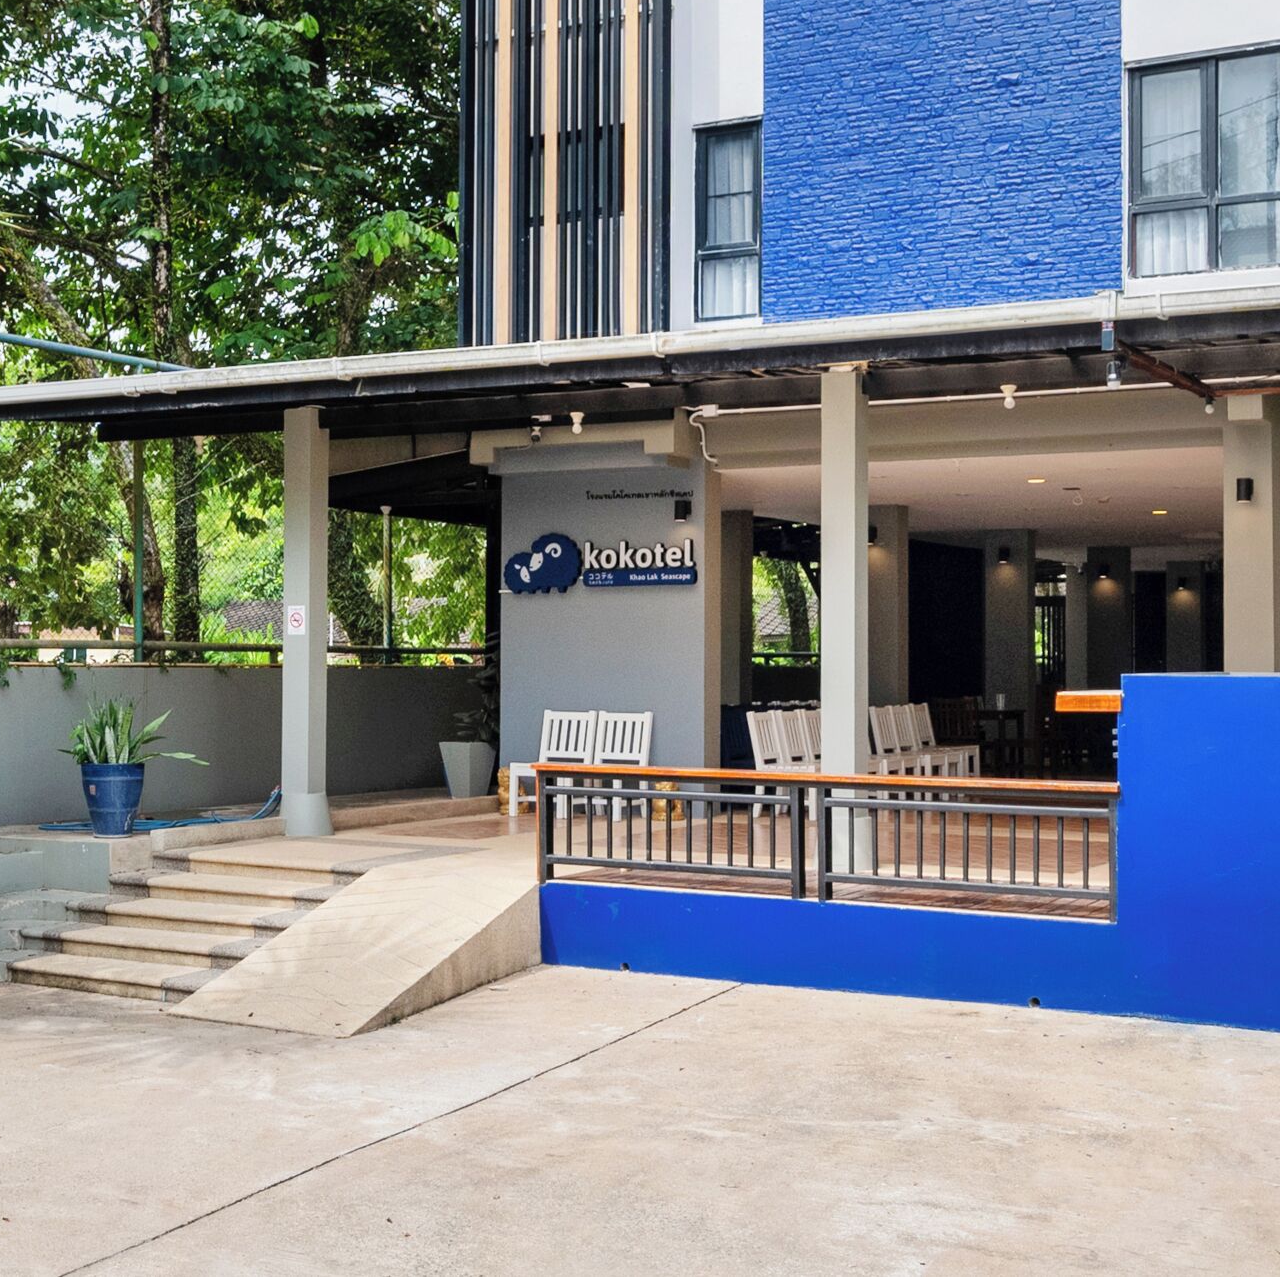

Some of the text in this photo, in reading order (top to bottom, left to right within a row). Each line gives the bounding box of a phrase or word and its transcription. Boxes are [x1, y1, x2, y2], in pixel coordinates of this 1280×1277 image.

[584, 538, 694, 569] kokotel
[588, 572, 614, 580] ココテル
[629, 572, 691, 582] Khao Lak Seascape
